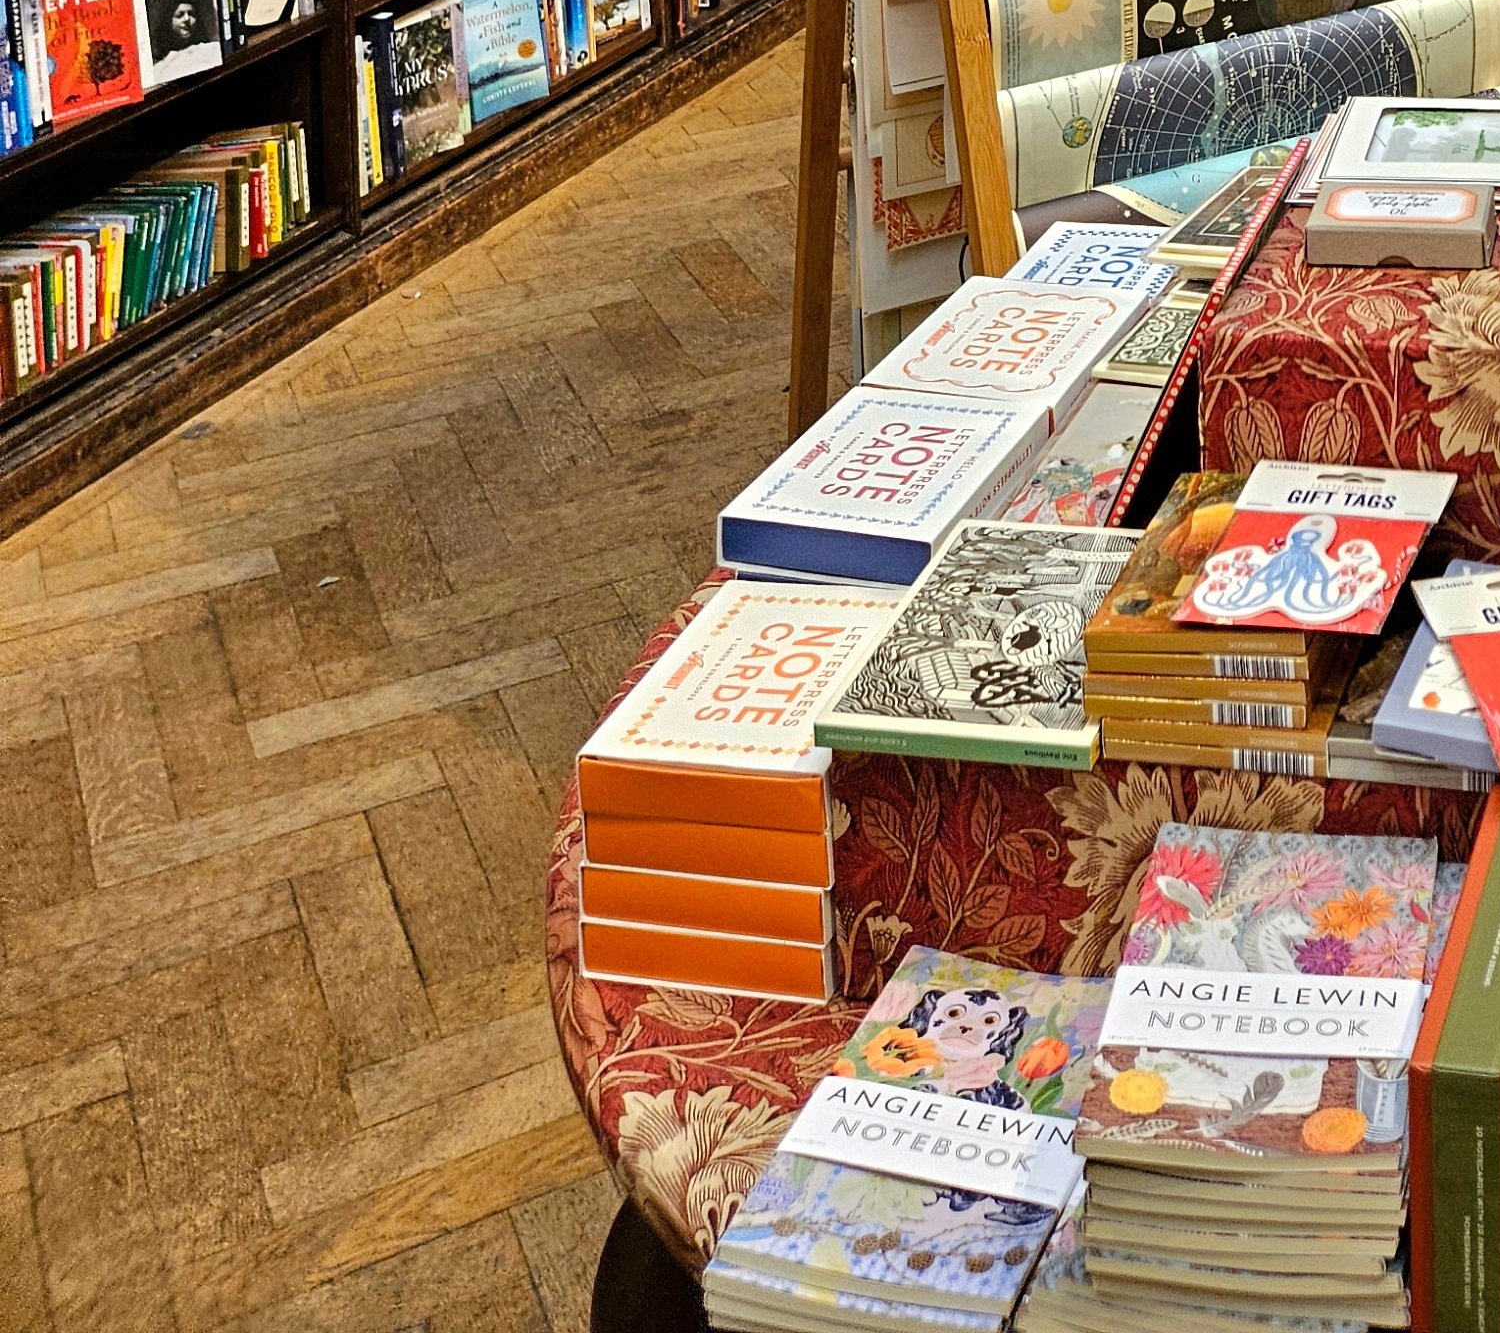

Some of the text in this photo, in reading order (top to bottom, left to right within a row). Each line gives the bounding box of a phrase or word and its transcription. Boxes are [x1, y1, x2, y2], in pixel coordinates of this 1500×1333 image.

[466, 1, 534, 29] Watermelon,
[483, 22, 505, 39] Fish
[490, 34, 518, 51] Bible
[950, 306, 1027, 369] CARDS
[976, 309, 1068, 375] NOTE
[1019, 311, 1087, 376] LETTERPRESS
[1075, 327, 1098, 353] THANK
[819, 422, 911, 497] CARDS
[852, 425, 957, 503] NOTE
[896, 427, 977, 506] LETTERPRESS
[950, 455, 977, 481] HELLO
[1286, 489, 1397, 510] GIFT TAGS
[694, 622, 795, 722] CARDS
[731, 625, 847, 726] NOTE
[783, 626, 868, 728] LETTERPRESS
[1128, 977, 1399, 1010] ANGIE LEWIN
[1147, 1008, 1372, 1038] NOTEBOOK
[826, 1083, 1078, 1146] ANGIE LEWIN
[830, 1114, 1040, 1174] NOTEBOOK
[1475, 1139, 1485, 1195] NOTECARDS
